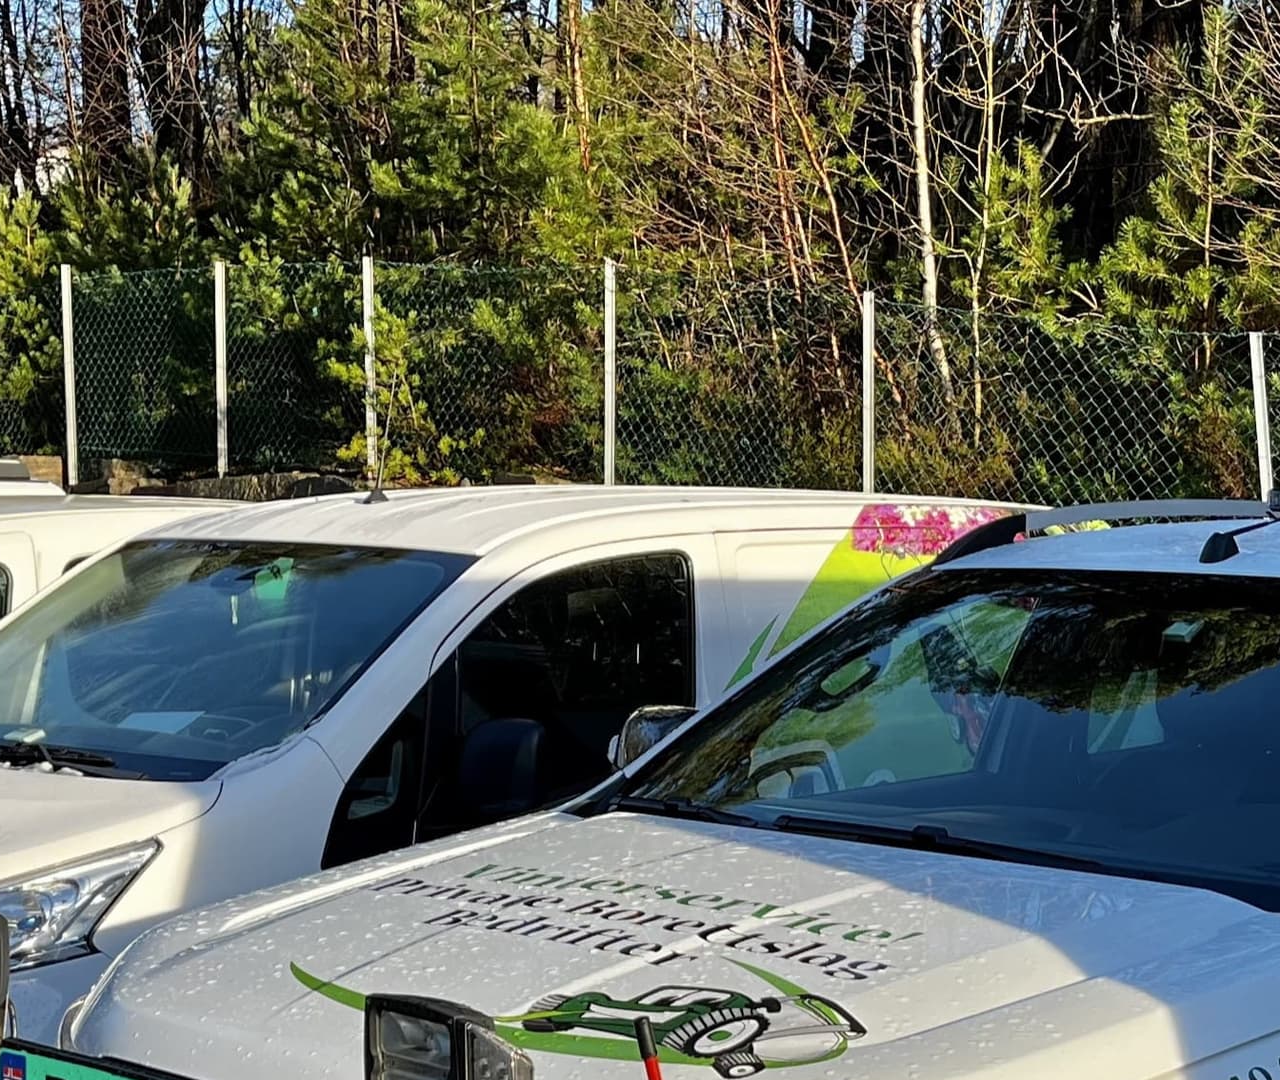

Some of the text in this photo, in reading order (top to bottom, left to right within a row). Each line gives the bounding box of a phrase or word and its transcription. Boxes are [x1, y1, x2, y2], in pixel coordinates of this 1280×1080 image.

[370, 878, 898, 980] Private Borettslag
[424, 909, 698, 965] Bedrifter
